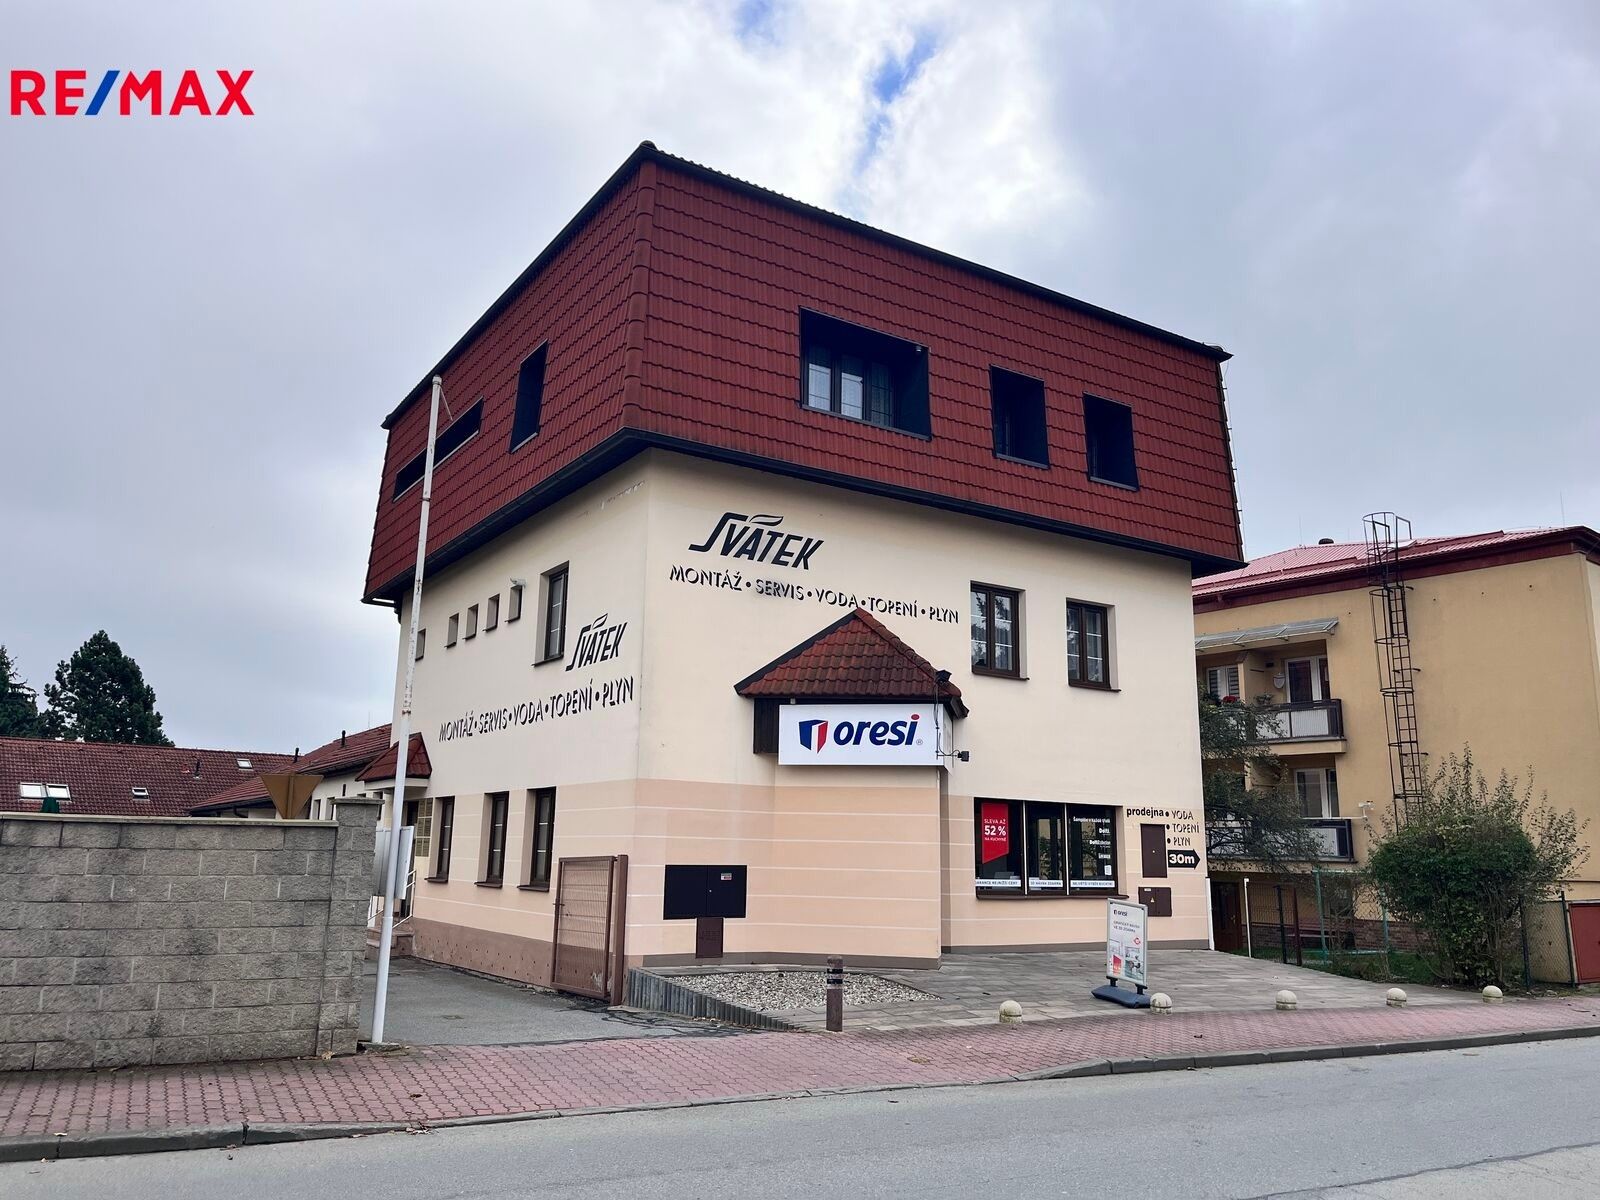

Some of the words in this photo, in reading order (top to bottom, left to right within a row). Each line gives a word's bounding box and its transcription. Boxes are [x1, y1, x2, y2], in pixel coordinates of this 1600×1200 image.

[669, 564, 742, 591] MONTÁŽ
[755, 578, 804, 601] SERVIS
[815, 587, 859, 609] VODA
[867, 596, 918, 618] TOPENÍ
[929, 605, 959, 624] PLYN
[439, 710, 474, 743] MONTÁŽ
[478, 708, 508, 734] SERVIS
[513, 699, 544, 726] VODA
[550, 678, 593, 719] TOPENÍ
[602, 675, 634, 708] PLYN
[833, 713, 920, 746] oresi
[1126, 807, 1164, 818] prodejna
[1171, 810, 1194, 820] VODA
[984, 825, 996, 836] 52
[997, 825, 1007, 836] %
[1172, 822, 1200, 834] TOPENÍ
[1173, 836, 1191, 846] PLYN
[1168, 853, 1195, 864] 30m
